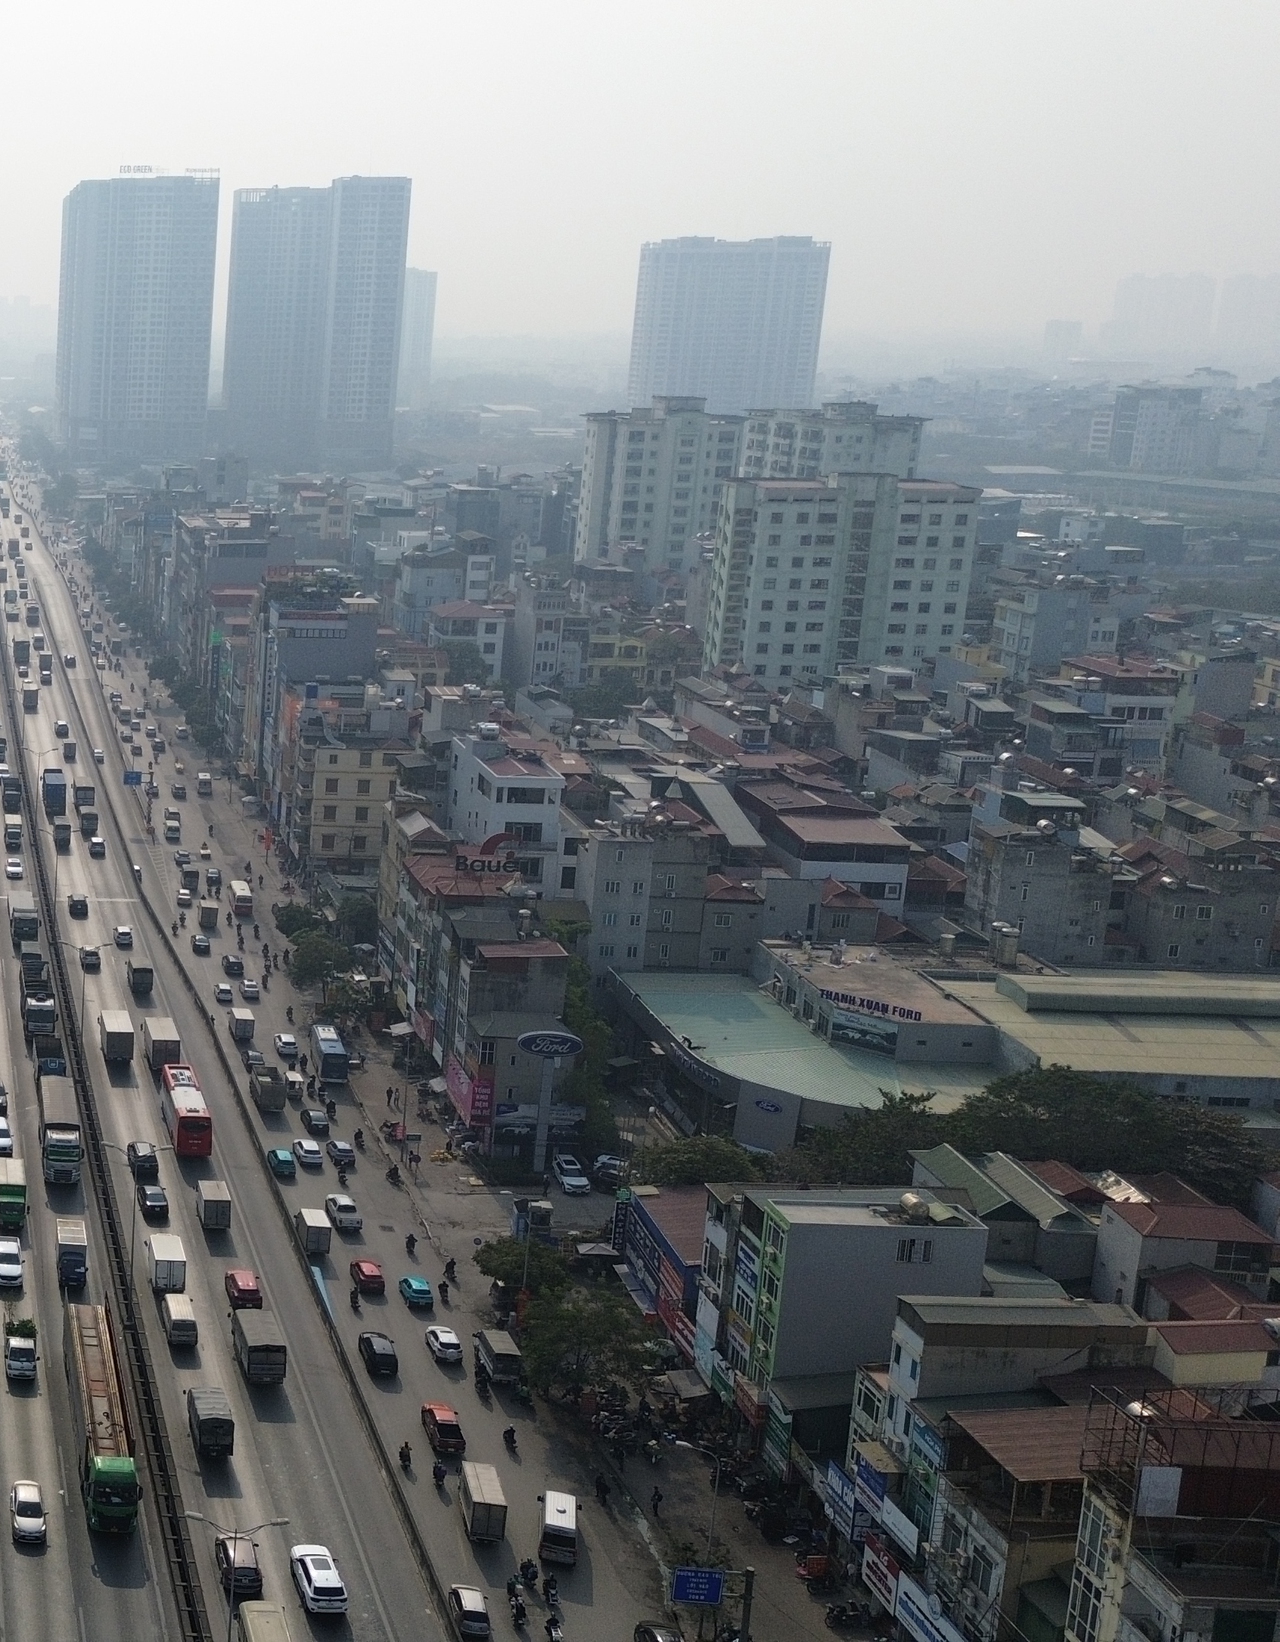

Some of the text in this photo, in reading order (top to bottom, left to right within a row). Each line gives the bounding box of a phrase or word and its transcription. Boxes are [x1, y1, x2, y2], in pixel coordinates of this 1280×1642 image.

[133, 165, 153, 174] GREEN
[819, 988, 923, 1022] THANH XUAN FORD
[531, 1035, 573, 1054] Ford
